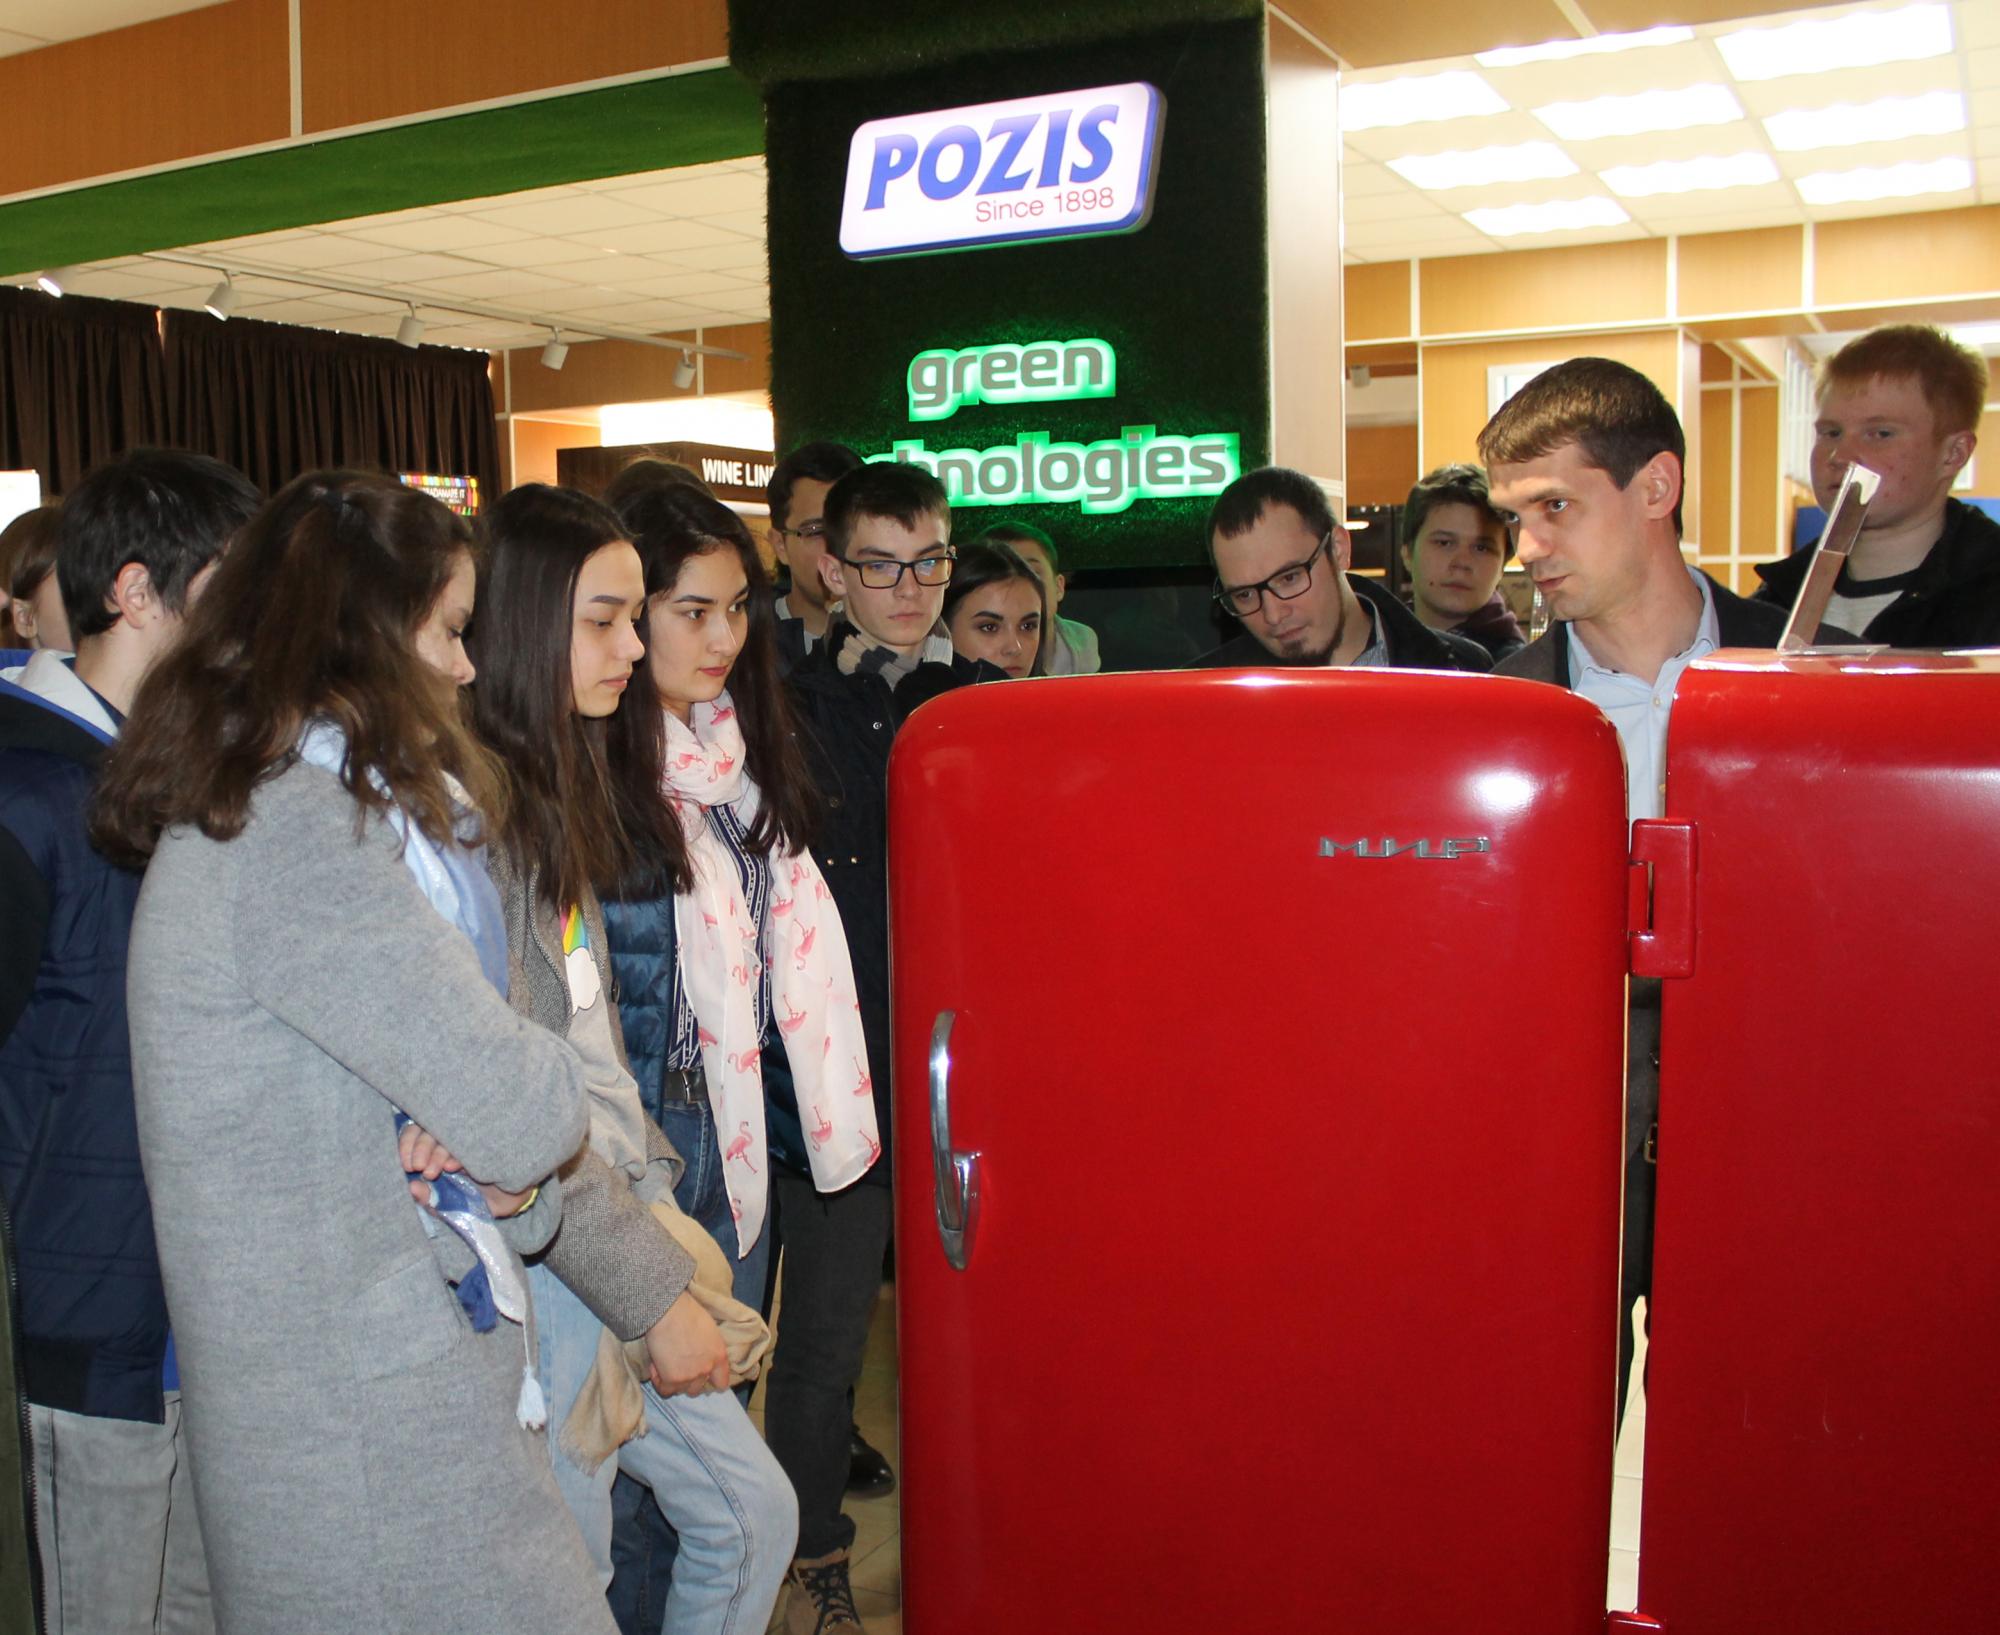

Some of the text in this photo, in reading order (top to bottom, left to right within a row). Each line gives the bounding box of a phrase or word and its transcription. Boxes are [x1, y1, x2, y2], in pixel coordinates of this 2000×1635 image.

[863, 104, 1119, 211] POZIS
[975, 187, 1115, 222] Since 1898
[911, 346, 1103, 408] green
[702, 458, 743, 486] WINE
